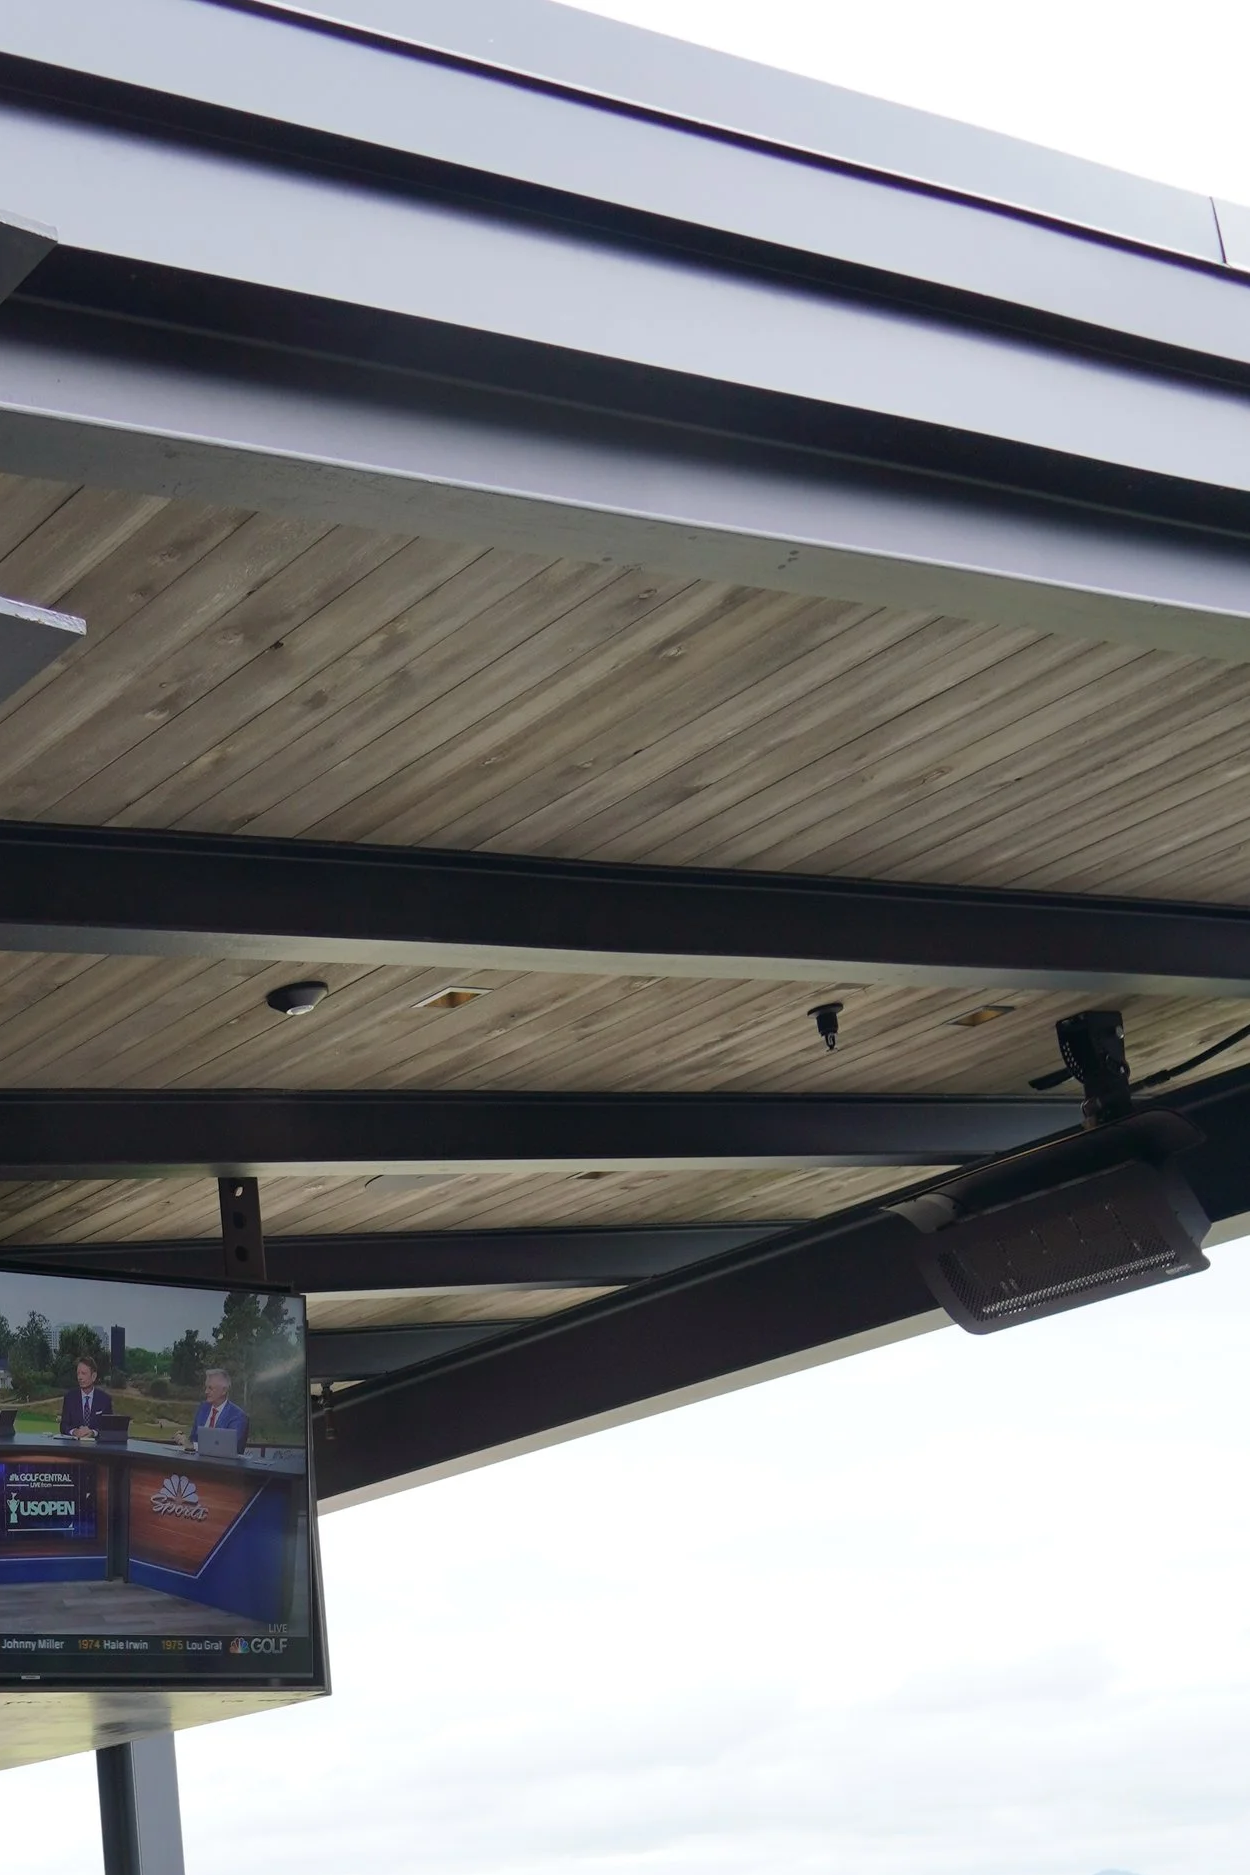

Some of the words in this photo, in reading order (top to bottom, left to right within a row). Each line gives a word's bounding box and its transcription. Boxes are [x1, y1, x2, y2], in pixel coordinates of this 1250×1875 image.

[151, 1494, 209, 1519] Sports
[268, 1623, 288, 1633] LIVE
[2, 1639, 36, 1651] Johnny
[38, 1639, 65, 1649] Miller
[78, 1639, 100, 1649] 1974
[103, 1640, 124, 1650] Hale
[126, 1640, 149, 1650] Irwin
[161, 1640, 184, 1650] 1975
[186, 1640, 203, 1650] Lou
[251, 1637, 288, 1653] GOLF
